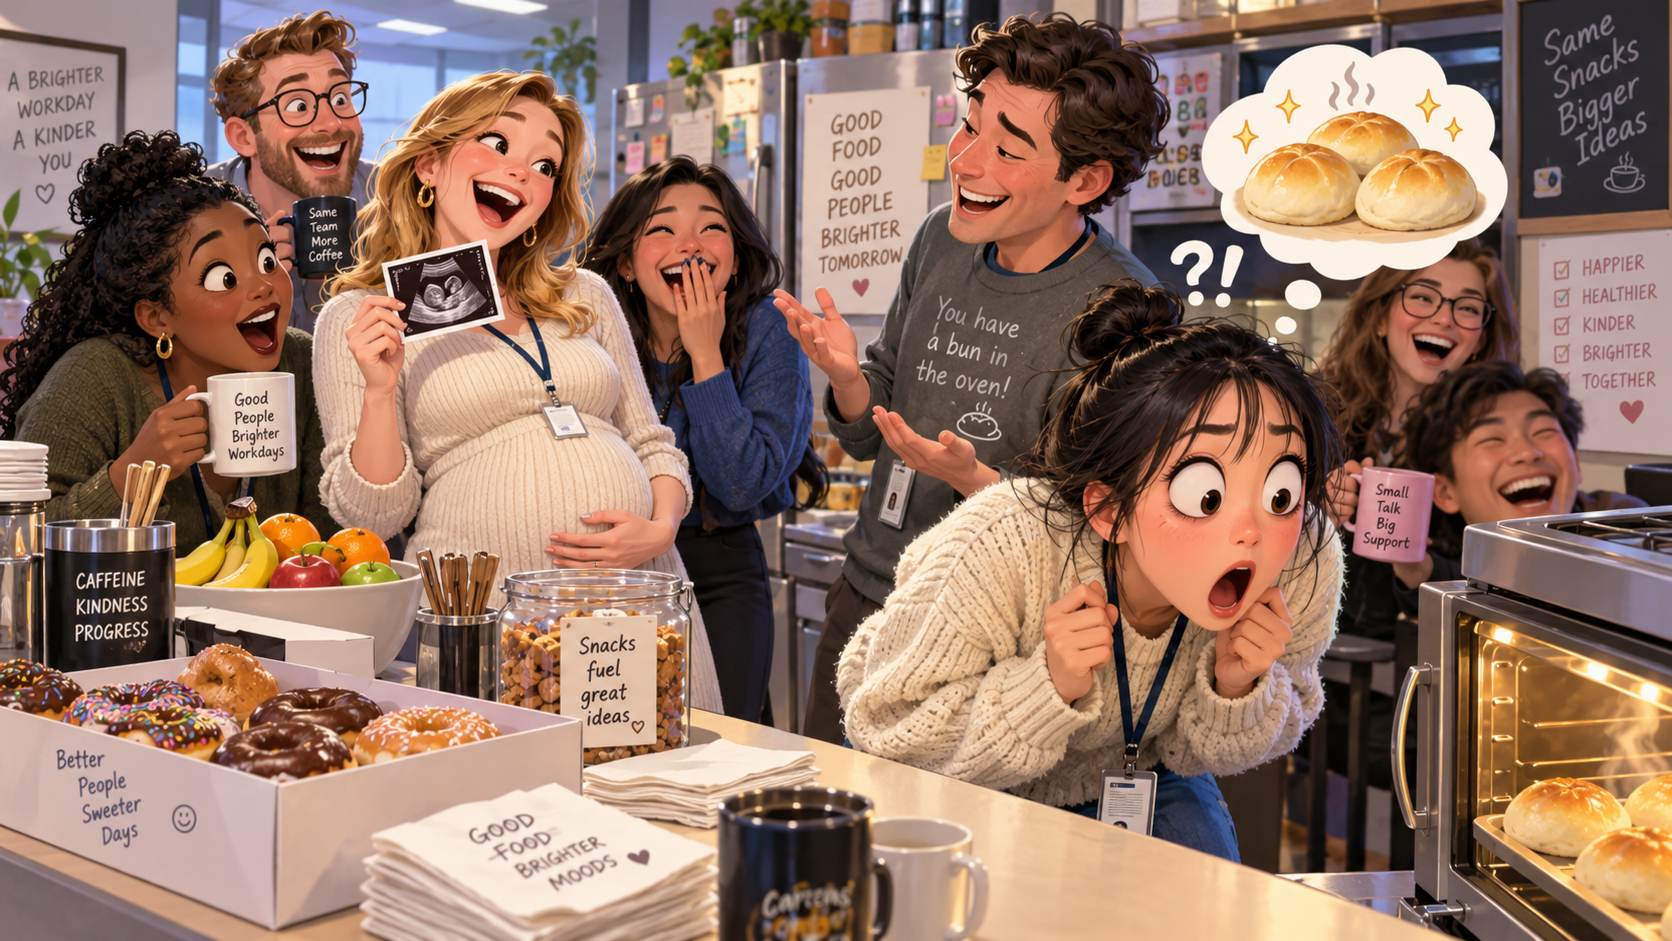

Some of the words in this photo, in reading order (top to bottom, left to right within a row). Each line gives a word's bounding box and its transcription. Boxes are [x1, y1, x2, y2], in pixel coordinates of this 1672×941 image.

[1544, 14, 1615, 66] Same
[7, 71, 20, 92] A
[28, 66, 105, 90] BRIGHTER
[1553, 37, 1639, 99] Snacks
[17, 91, 95, 119] WORKDAY
[1557, 76, 1640, 136] Bigger
[830, 109, 883, 136] GOOD
[13, 129, 25, 151] A
[34, 120, 97, 147] KINDER
[1574, 110, 1648, 167] Ideas
[832, 136, 882, 162] FOOD
[39, 151, 72, 175] YOU
[830, 165, 882, 191] GOOD
[308, 207, 338, 219] Same
[827, 191, 894, 220] PEOPLE
[309, 222, 338, 233] Team
[821, 219, 901, 249] BRIGHTER
[311, 237, 339, 247] More
[308, 250, 343, 263] Coffee
[818, 246, 904, 274] TOMORROW
[1582, 254, 1645, 277] HAPPIER
[1582, 283, 1658, 305] HEALTHIER
[936, 295, 967, 326] You
[973, 306, 1020, 339] have
[1583, 314, 1636, 334] KINDER
[927, 336, 939, 351] a
[946, 332, 981, 361] bun
[989, 345, 1008, 368] in
[1583, 342, 1652, 362] BRIGHTER
[916, 359, 947, 386] the
[955, 376, 1012, 400] oven!
[1582, 370, 1657, 390] TOGETHER
[234, 391, 269, 407] Good
[234, 411, 275, 427] People
[232, 428, 280, 445] Brighter
[228, 445, 285, 462] Workdays
[1375, 483, 1409, 499] Small
[1377, 500, 1401, 515] Talk
[1376, 516, 1396, 535] Big
[1363, 531, 1410, 551] Support
[76, 570, 146, 590] CAFFEINE
[76, 596, 148, 616] KINDNESS
[75, 620, 149, 642] PROGRESS
[579, 634, 636, 655] Snacks
[587, 658, 621, 682] fuel
[581, 683, 627, 710] great
[587, 707, 630, 726] ideas
[56, 749, 105, 770] Better
[78, 770, 127, 799] People
[82, 797, 141, 824] Sweeter
[101, 824, 138, 848] Days
[468, 813, 535, 845] GOOD
[492, 831, 552, 862] FOOD
[514, 836, 606, 879] BRIGHTER
[548, 855, 618, 892] MOODS
